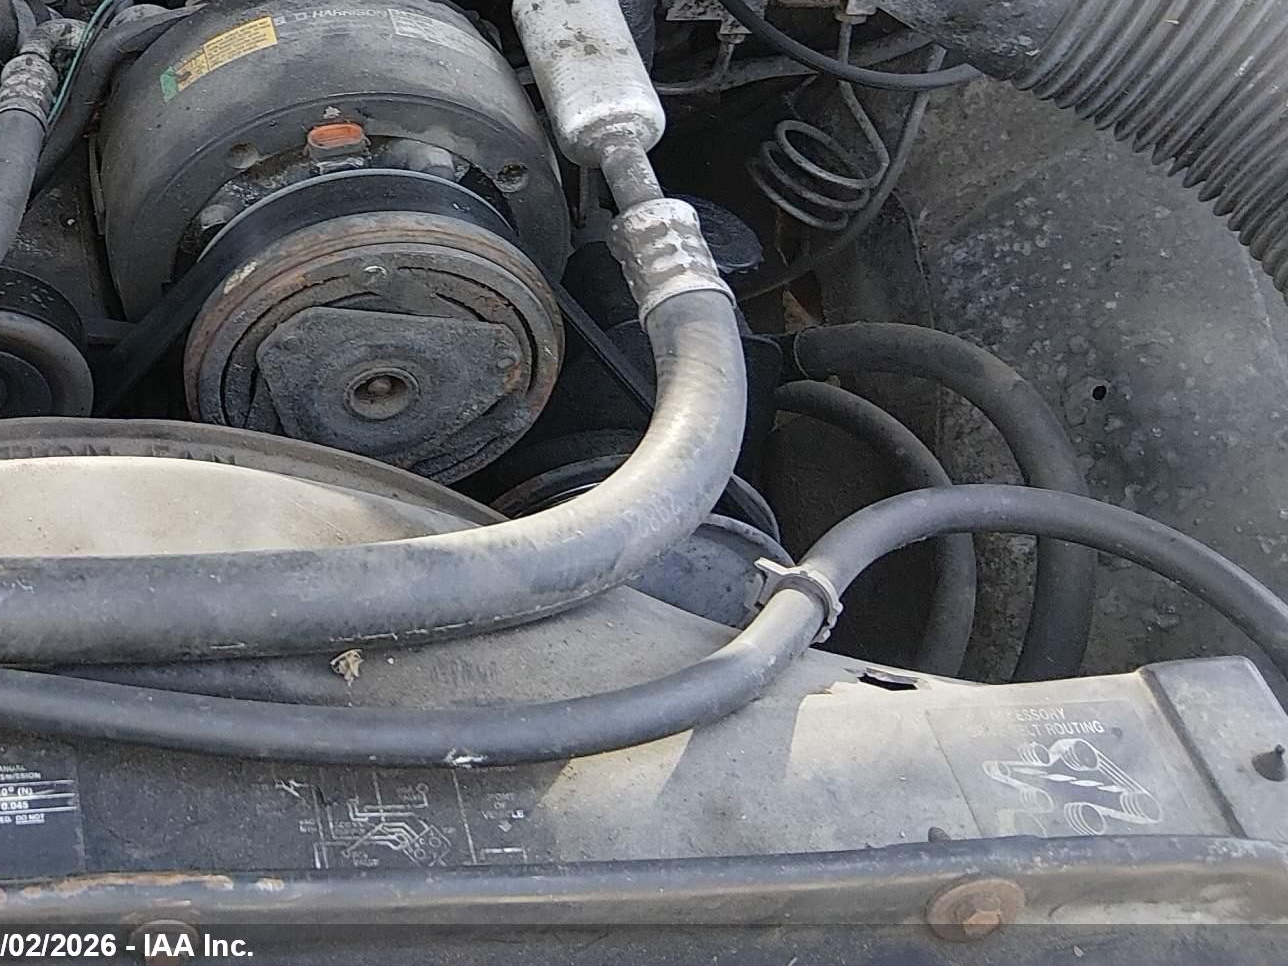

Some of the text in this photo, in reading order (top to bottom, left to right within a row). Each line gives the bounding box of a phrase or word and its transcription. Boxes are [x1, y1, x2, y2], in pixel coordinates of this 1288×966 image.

[1045, 720, 1105, 736] ROUTING
[17, 786, 33, 797] (N)
[0, 801, 29, 811] 0.045
[15, 814, 28, 822] DO
[29, 813, 45, 821] NOT
